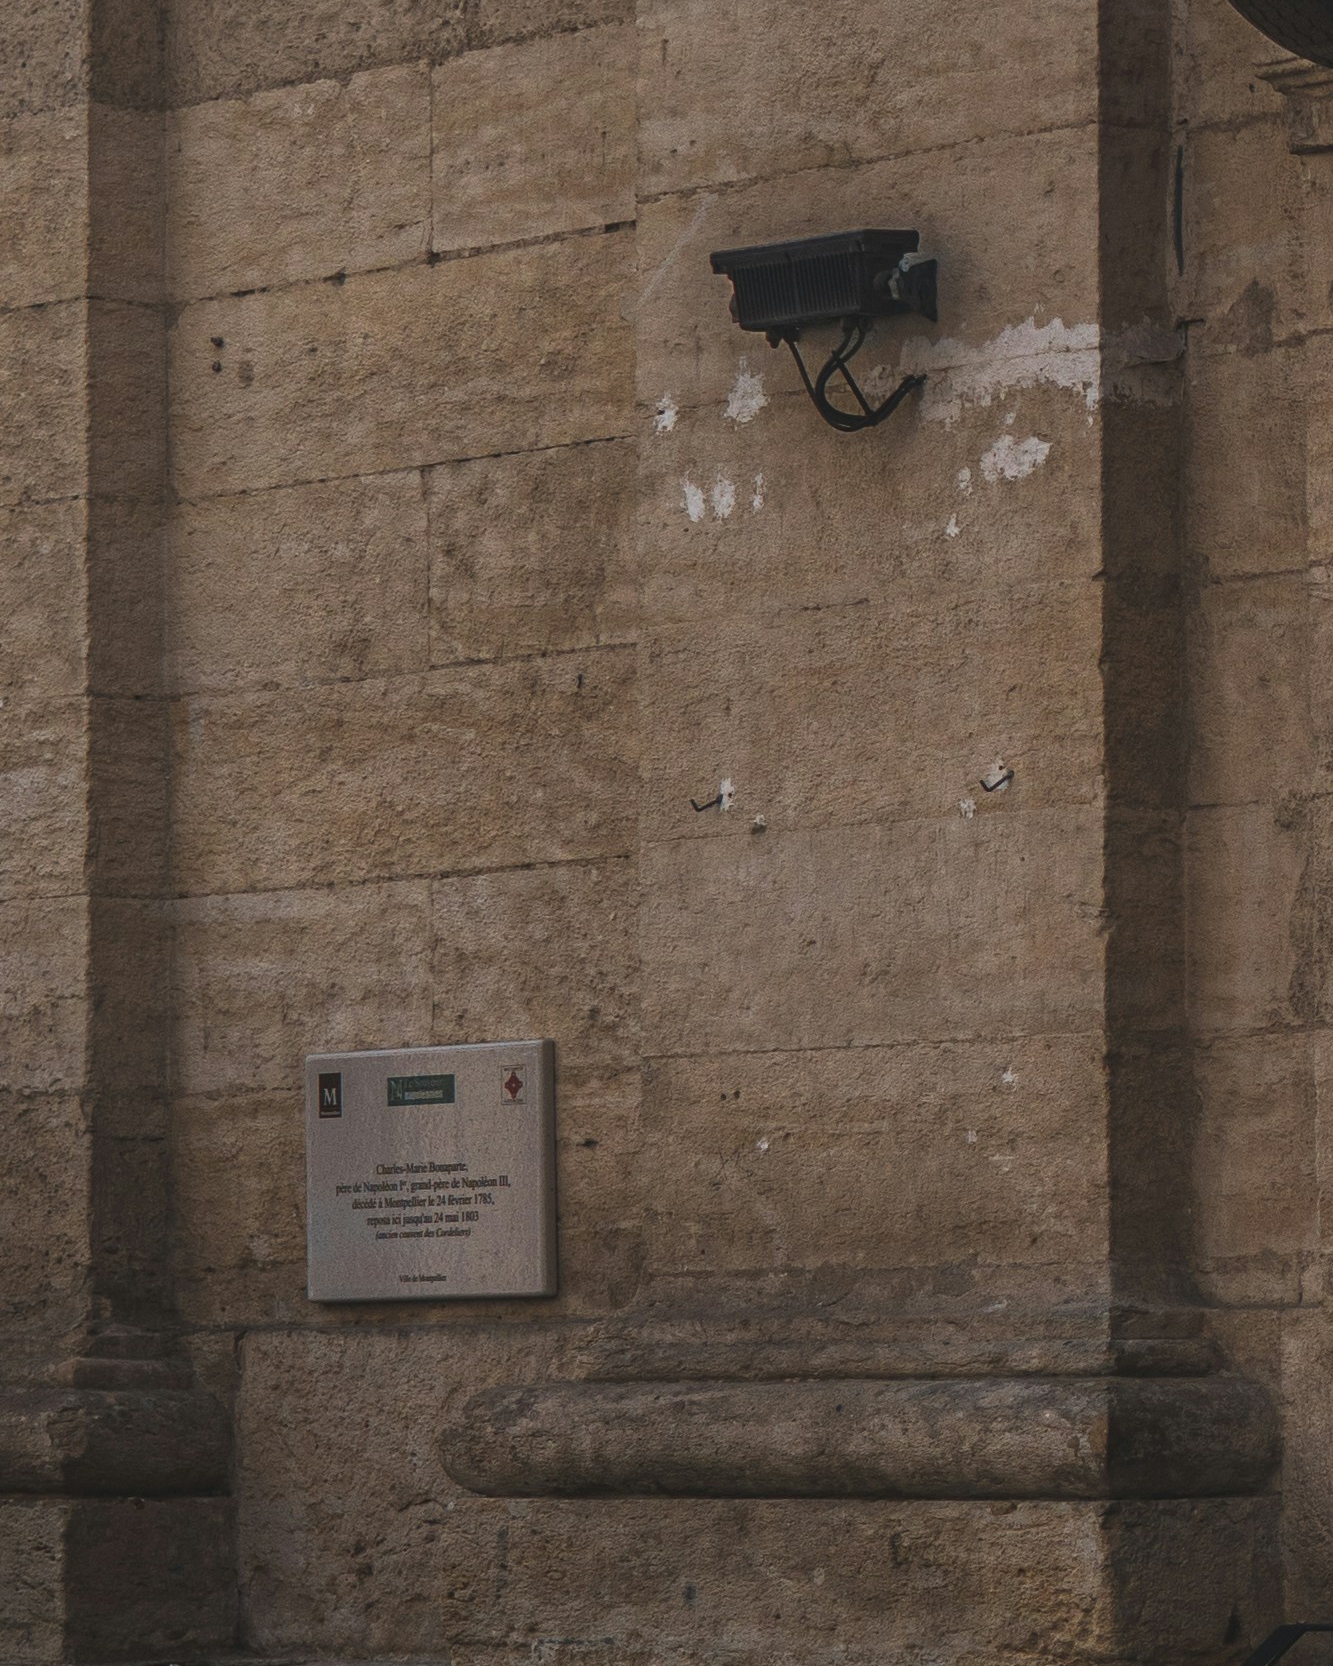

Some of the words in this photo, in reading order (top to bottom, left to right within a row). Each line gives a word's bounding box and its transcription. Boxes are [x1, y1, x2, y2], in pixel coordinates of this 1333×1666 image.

[323, 1087, 337, 1106] M
[376, 1163, 428, 1175] Charles-Marie
[429, 1162, 468, 1175] Bonaparte,
[336, 1183, 352, 1197] père
[353, 1182, 362, 1193] de
[363, 1181, 398, 1195] Napoléon
[411, 1178, 450, 1193] grand-père
[451, 1177, 460, 1189] de
[461, 1176, 498, 1191] Napoléon
[499, 1175, 511, 1188] III,
[352, 1198, 377, 1210] décédé
[385, 1196, 427, 1210] Montpellier
[428, 1195, 435, 1206] le
[436, 1195, 446, 1206] 24
[448, 1194, 472, 1206] février
[367, 1216, 391, 1228] reposa
[392, 1214, 401, 1225] ici
[434, 1213, 443, 1223] 24
[445, 1211, 459, 1223] mai
[461, 1211, 479, 1222] 1803
[424, 1228, 435, 1238] des
[399, 1274, 411, 1283] Ville
[412, 1275, 418, 1283] de
